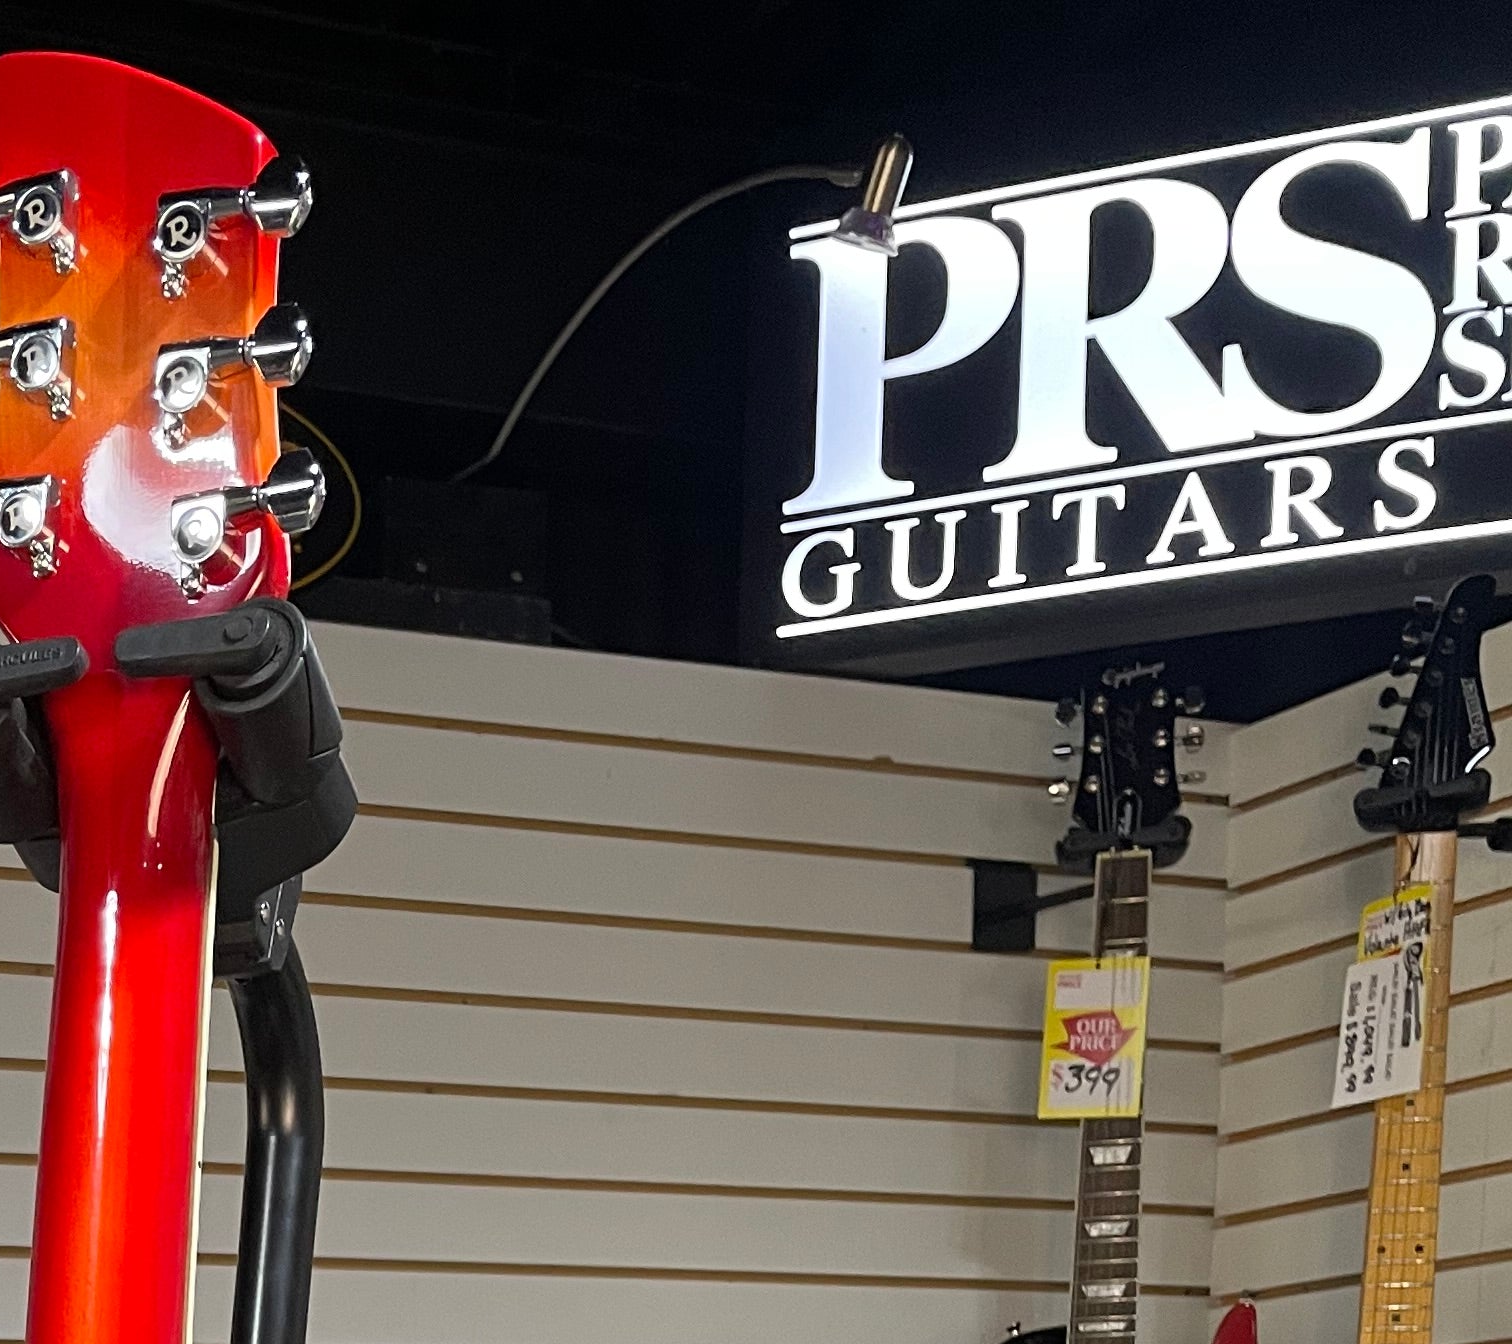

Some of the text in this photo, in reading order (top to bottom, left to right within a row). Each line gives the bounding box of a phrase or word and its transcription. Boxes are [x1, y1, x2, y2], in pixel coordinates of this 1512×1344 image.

[23, 198, 57, 228] R
[167, 214, 197, 249] R
[781, 126, 1438, 516] PRS
[781, 435, 1439, 620] GUITARS
[1069, 1034, 1122, 1051] PRICE
[1076, 1017, 1116, 1036] OUR
[1052, 1064, 1121, 1097] $399
